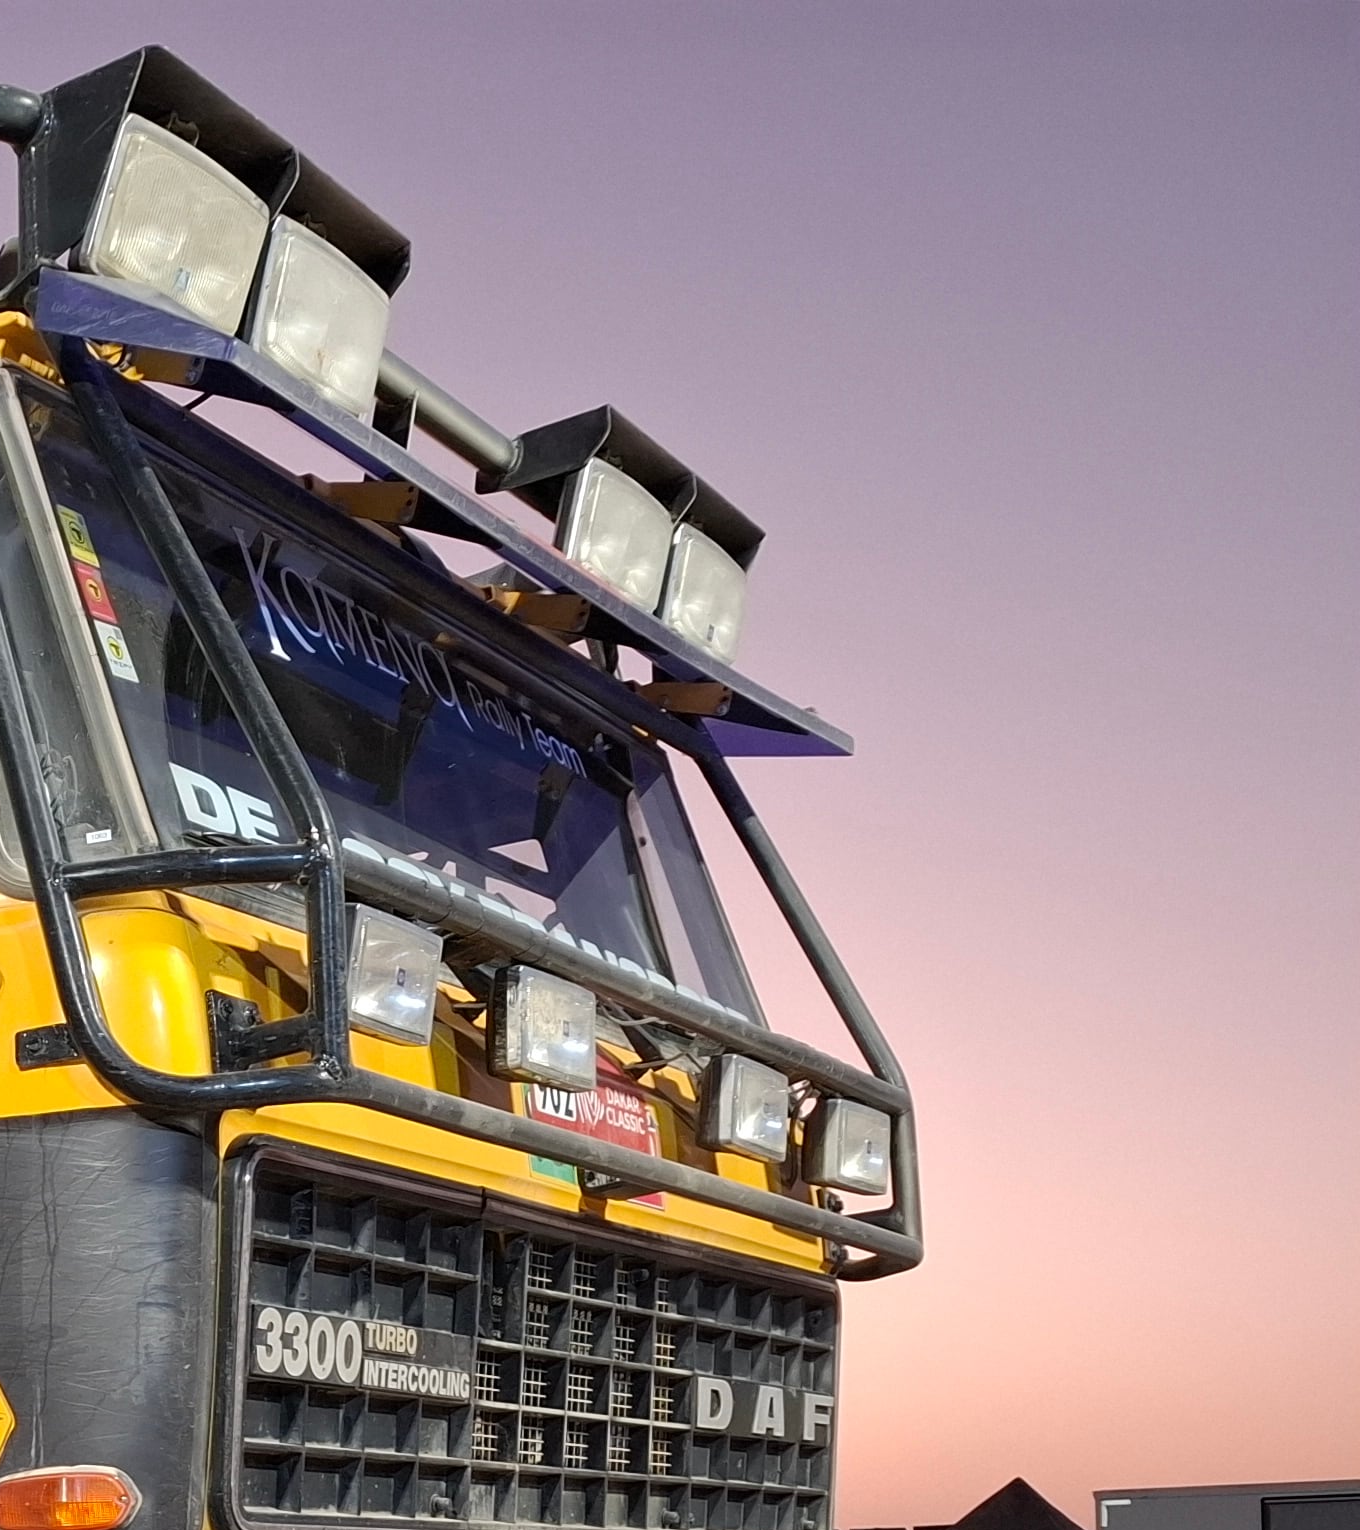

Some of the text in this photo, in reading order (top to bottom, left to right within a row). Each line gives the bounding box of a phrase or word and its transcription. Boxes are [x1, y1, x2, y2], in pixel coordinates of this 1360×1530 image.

[466, 680, 525, 751] Rally
[521, 714, 587, 779] Team
[605, 1087, 640, 1111] DAKAR
[605, 1107, 646, 1135] CLASSIC
[255, 1306, 363, 1384] 3300
[364, 1321, 418, 1357] TURBO
[362, 1359, 470, 1400] INTERCOOLING
